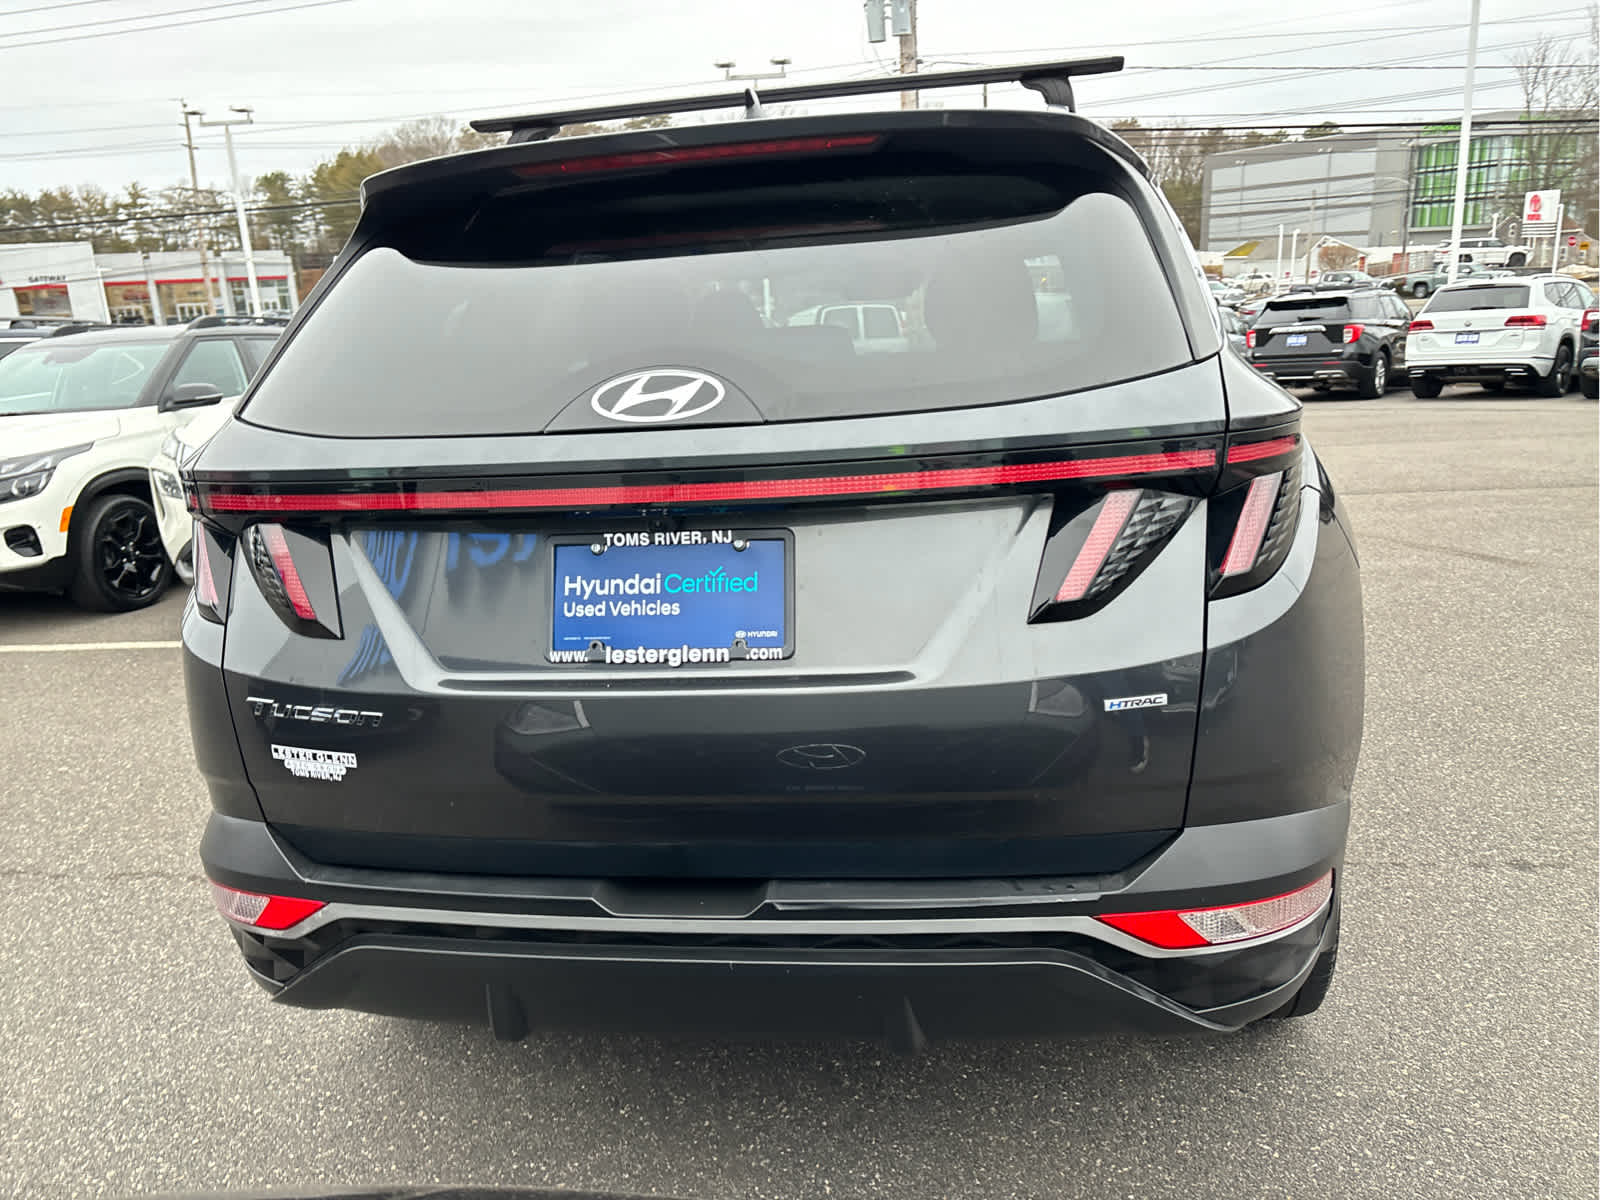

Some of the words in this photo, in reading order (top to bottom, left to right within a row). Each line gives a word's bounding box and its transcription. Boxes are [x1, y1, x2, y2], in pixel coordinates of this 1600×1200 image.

[28, 275, 67, 283] GATEWAY
[604, 532, 650, 547] TOMS
[654, 531, 707, 546] RIVER,
[711, 530, 732, 544] NJ
[564, 573, 662, 600] Hyundai
[664, 565, 758, 593] Certified
[563, 601, 605, 617] Used
[609, 600, 681, 616] Vehicles
[747, 630, 778, 638] HYUNDAI
[549, 650, 589, 663] www.
[605, 645, 730, 668] lesterglenn
[746, 647, 783, 660] .com
[246, 696, 384, 727] TUCSON
[1108, 696, 1164, 710] HTRAC
